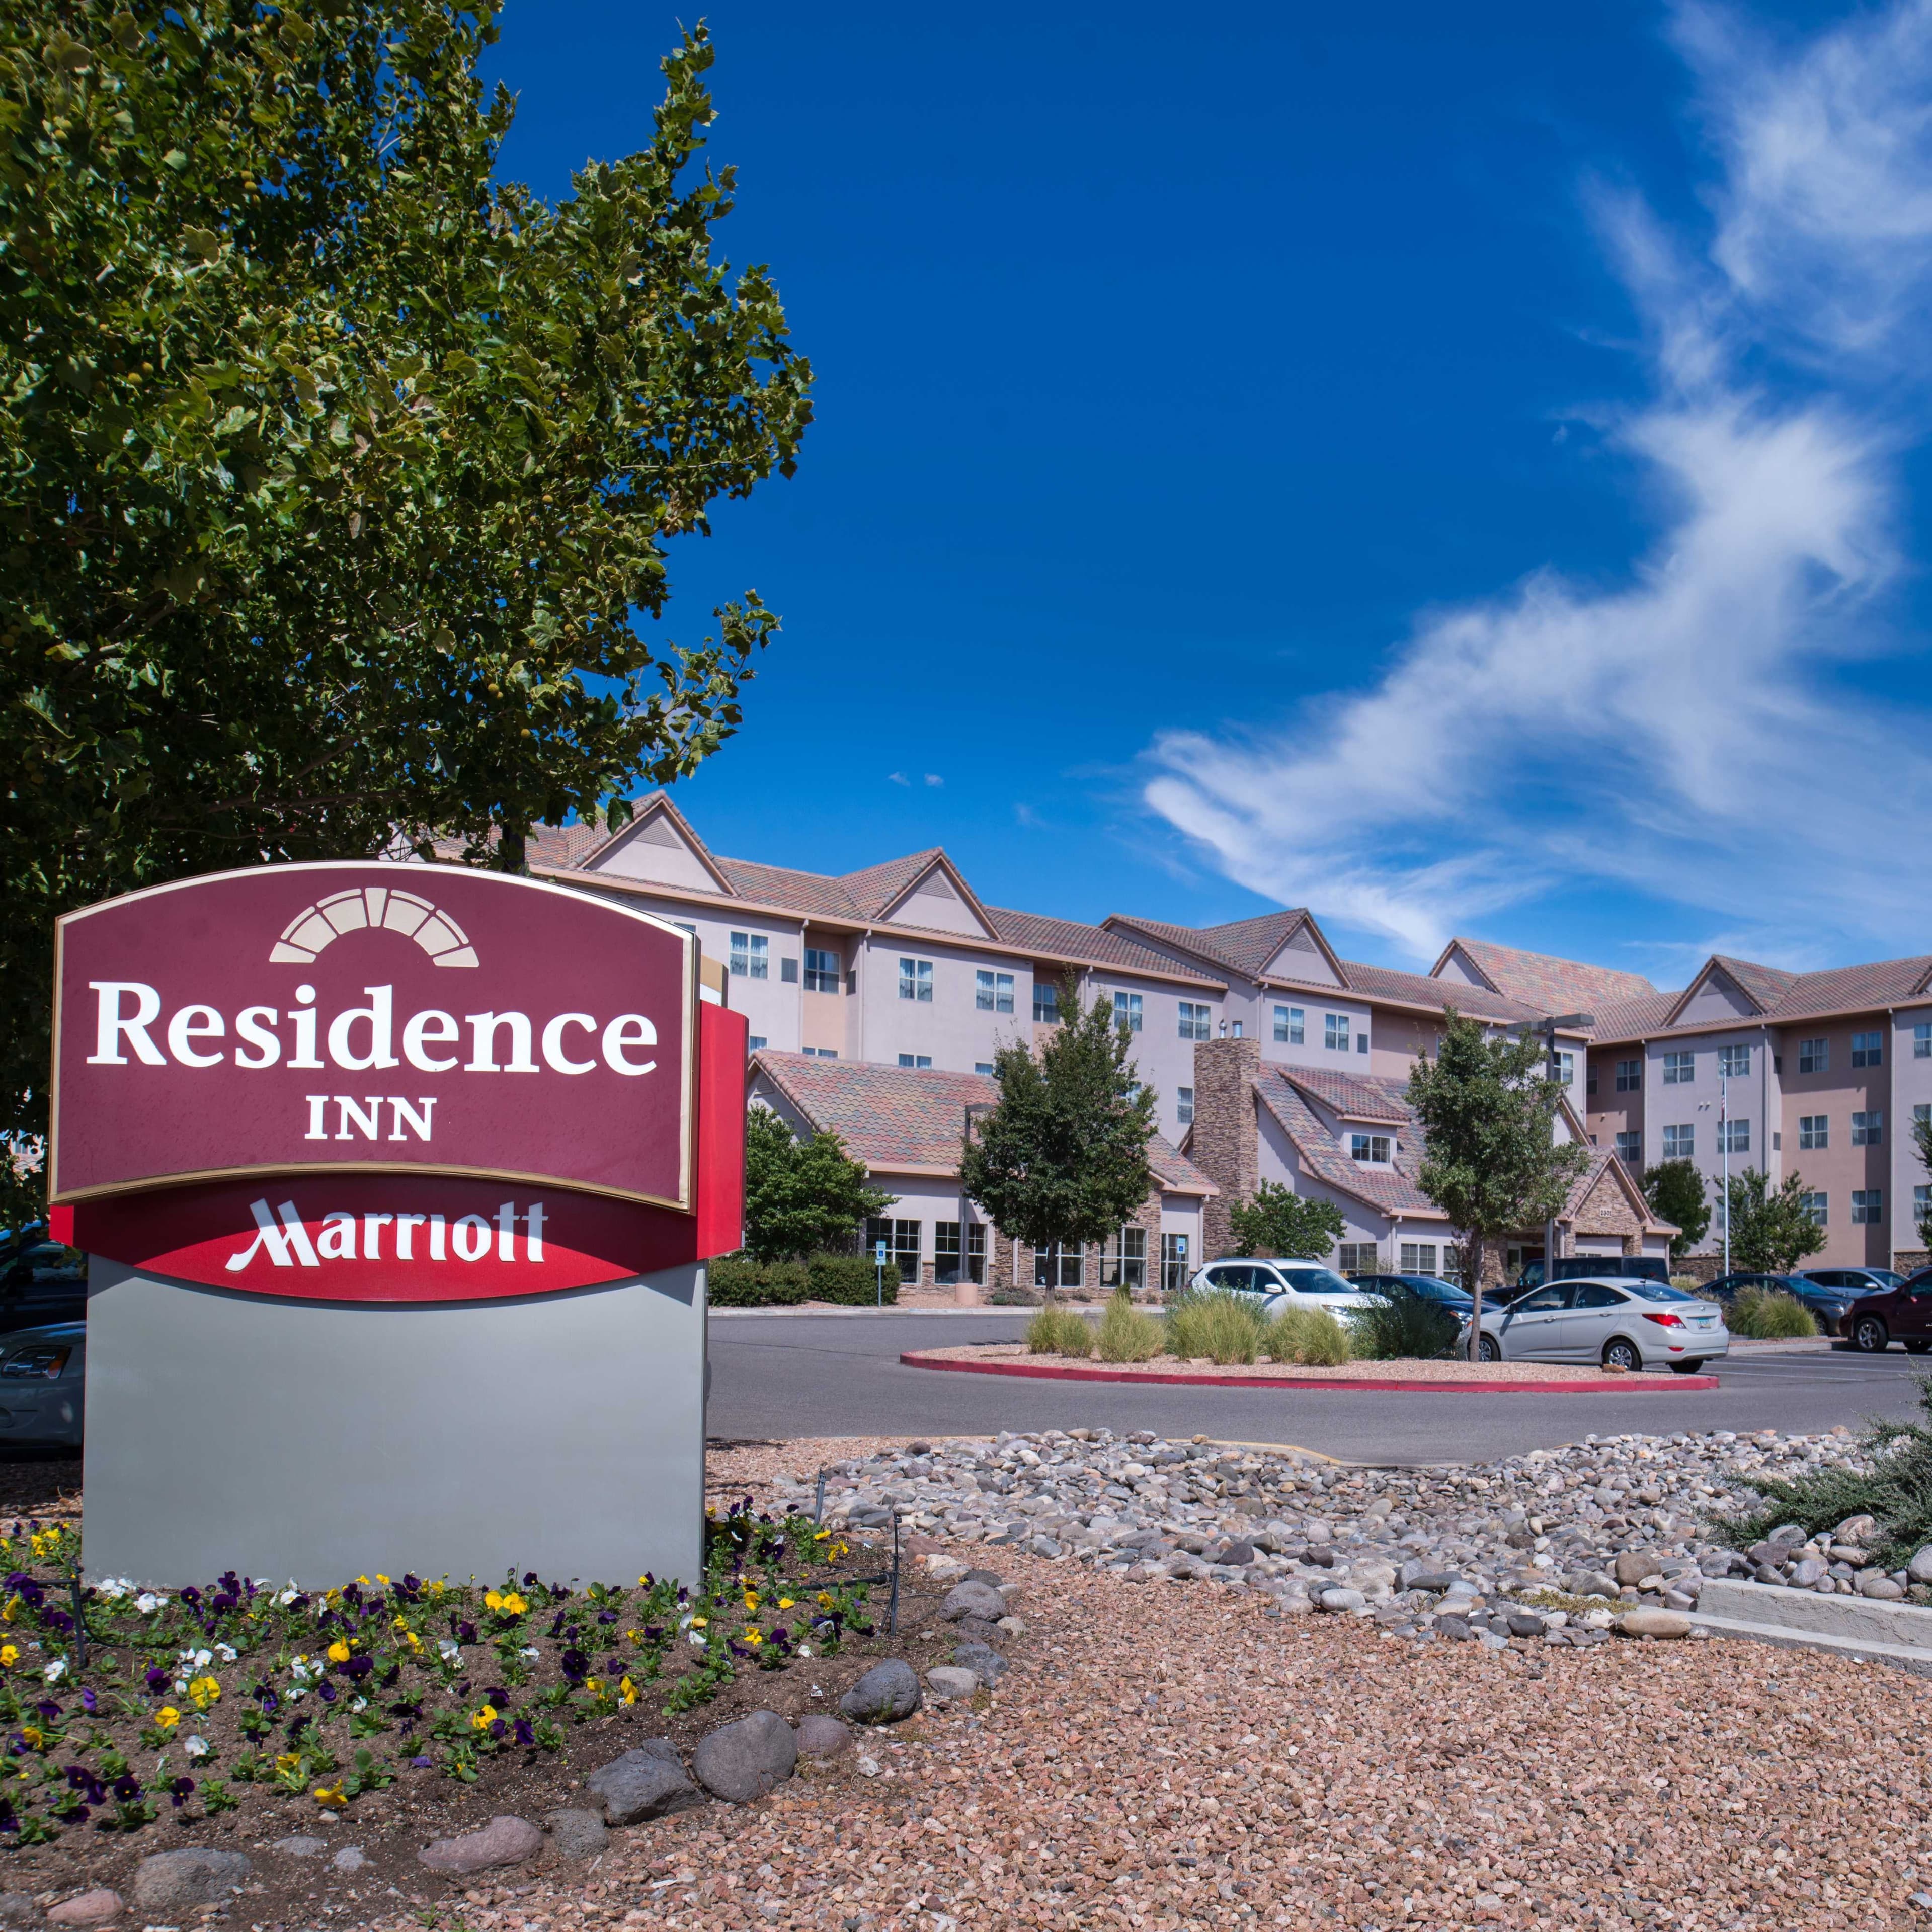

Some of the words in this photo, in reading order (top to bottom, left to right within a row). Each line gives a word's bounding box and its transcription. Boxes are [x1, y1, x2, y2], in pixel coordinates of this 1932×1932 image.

[86, 981, 658, 1076] Residence
[304, 1095, 438, 1142] INN
[225, 1198, 549, 1271] Marriott
